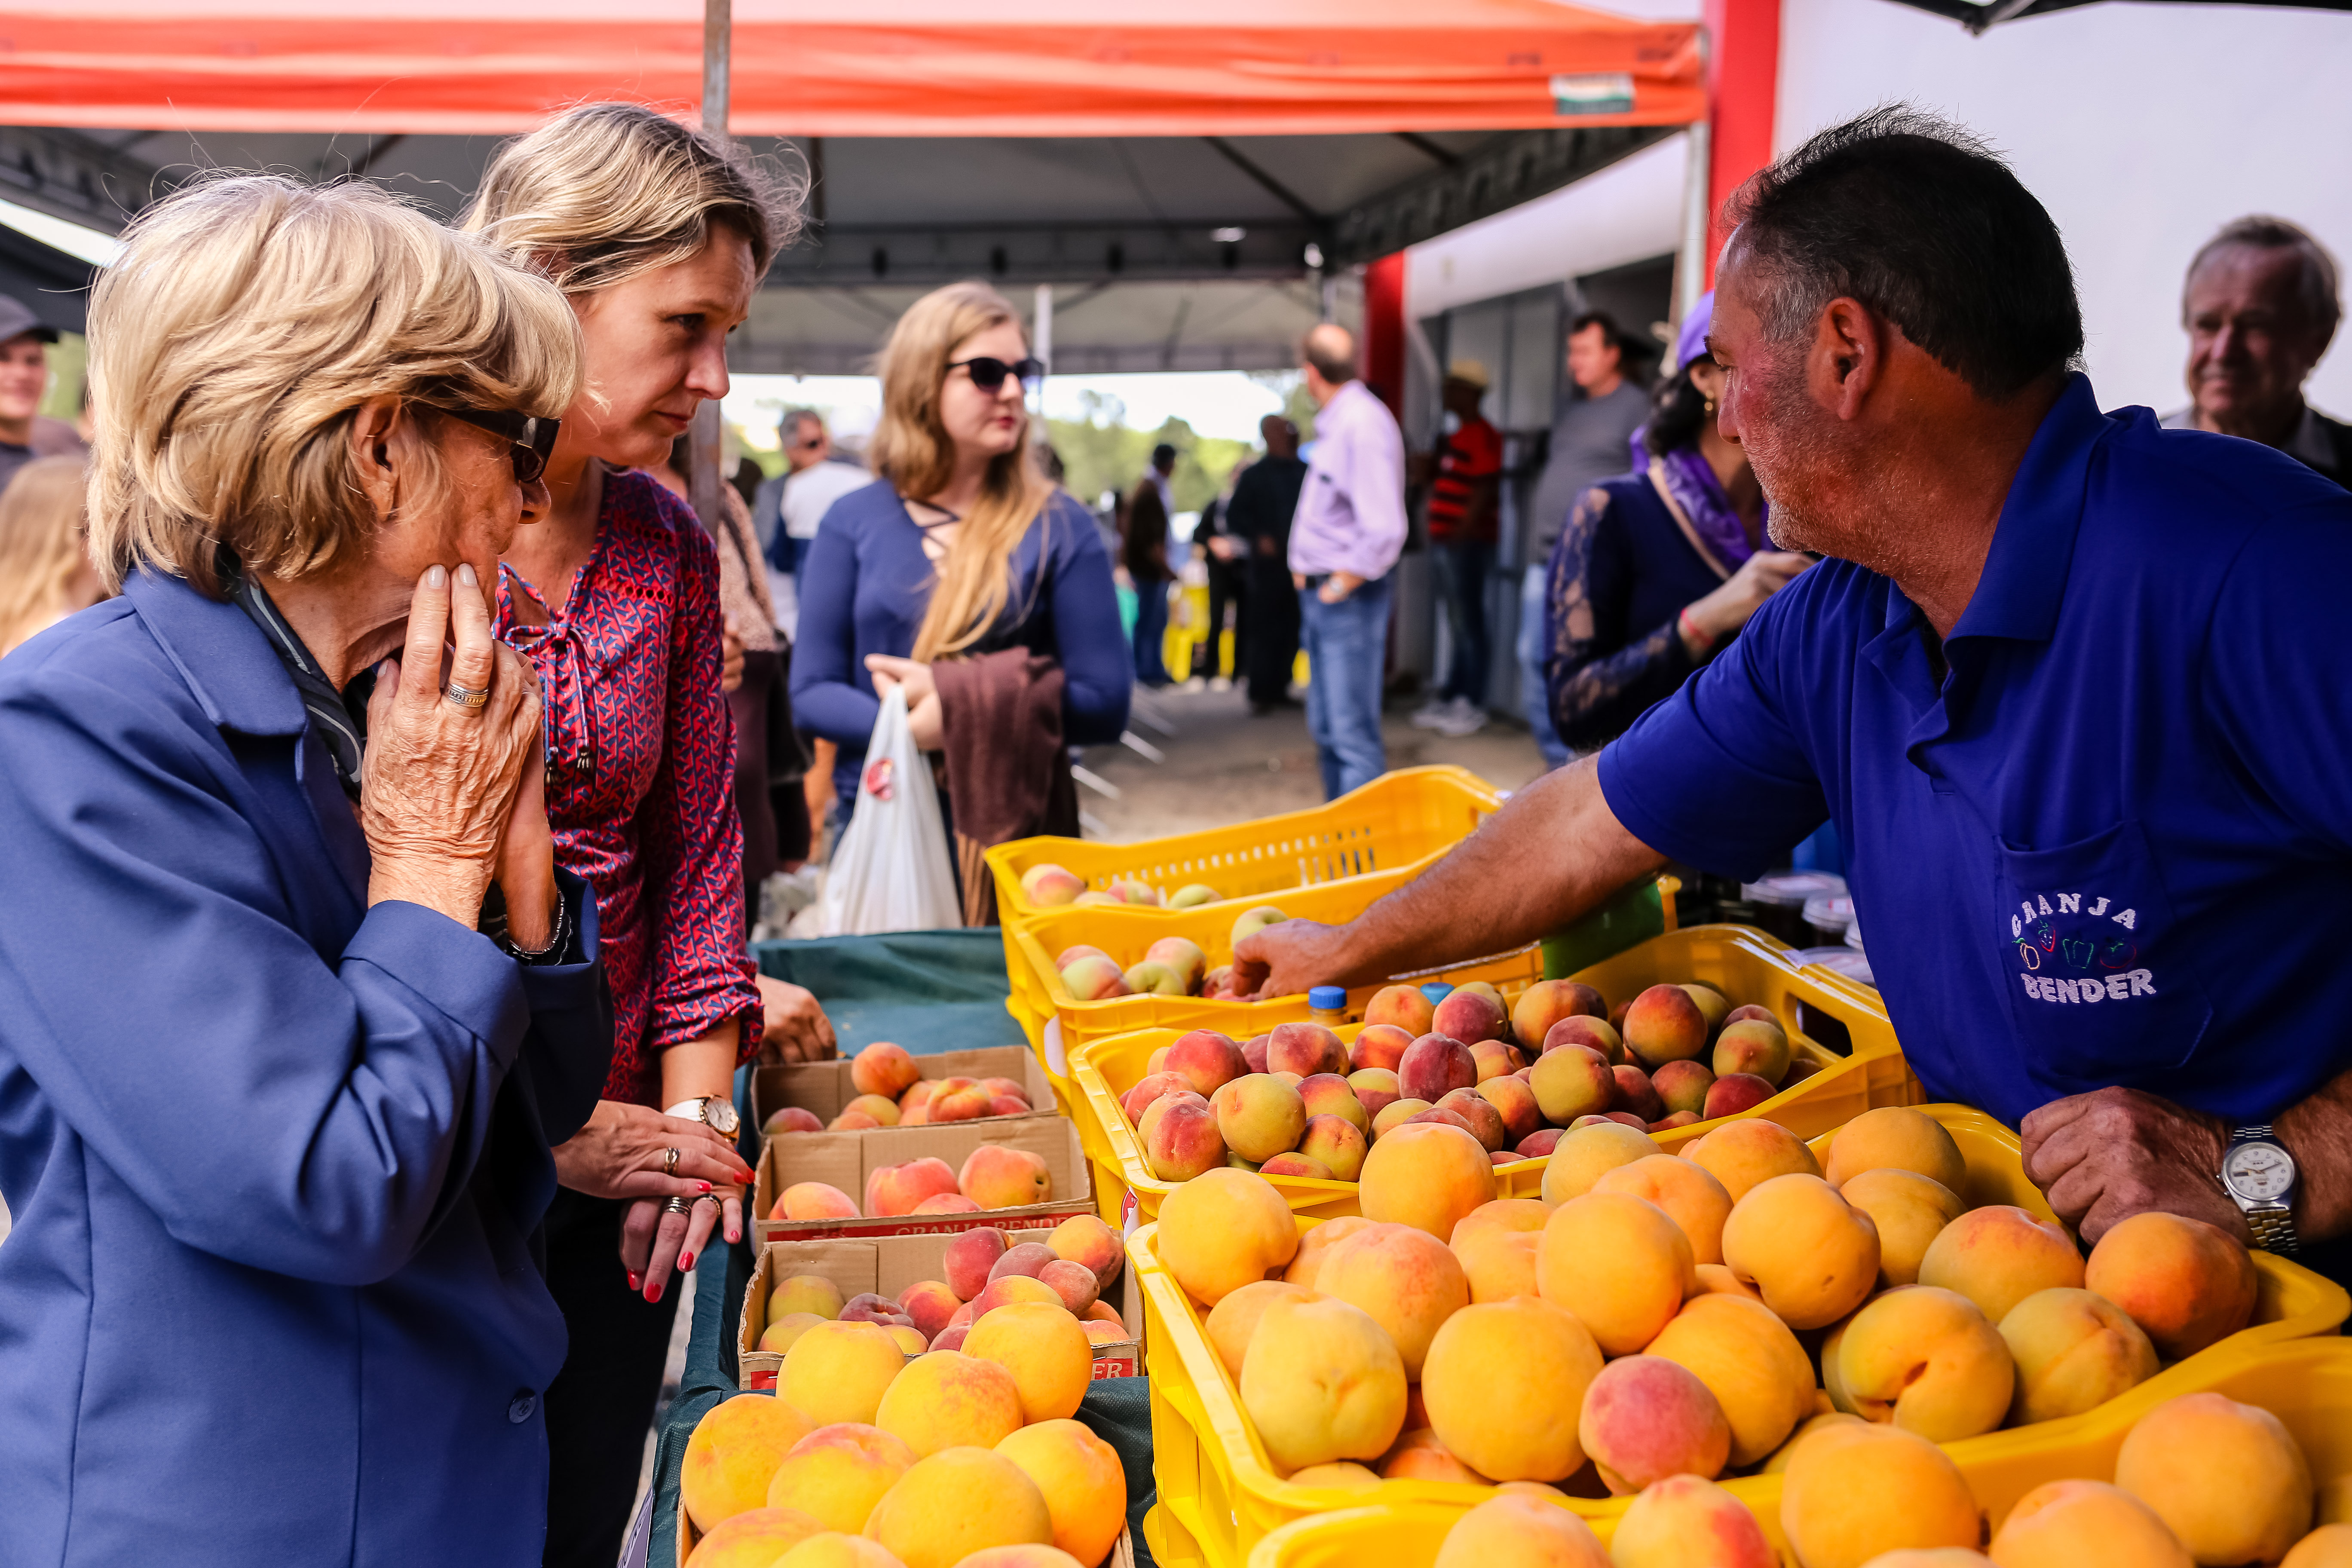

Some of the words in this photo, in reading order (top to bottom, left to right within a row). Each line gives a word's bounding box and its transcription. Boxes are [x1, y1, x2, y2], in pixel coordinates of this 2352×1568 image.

[2012, 893, 2136, 937] GRANJA
[2021, 969, 2156, 1003] BENDER
[895, 1223, 982, 1235] GRAN
